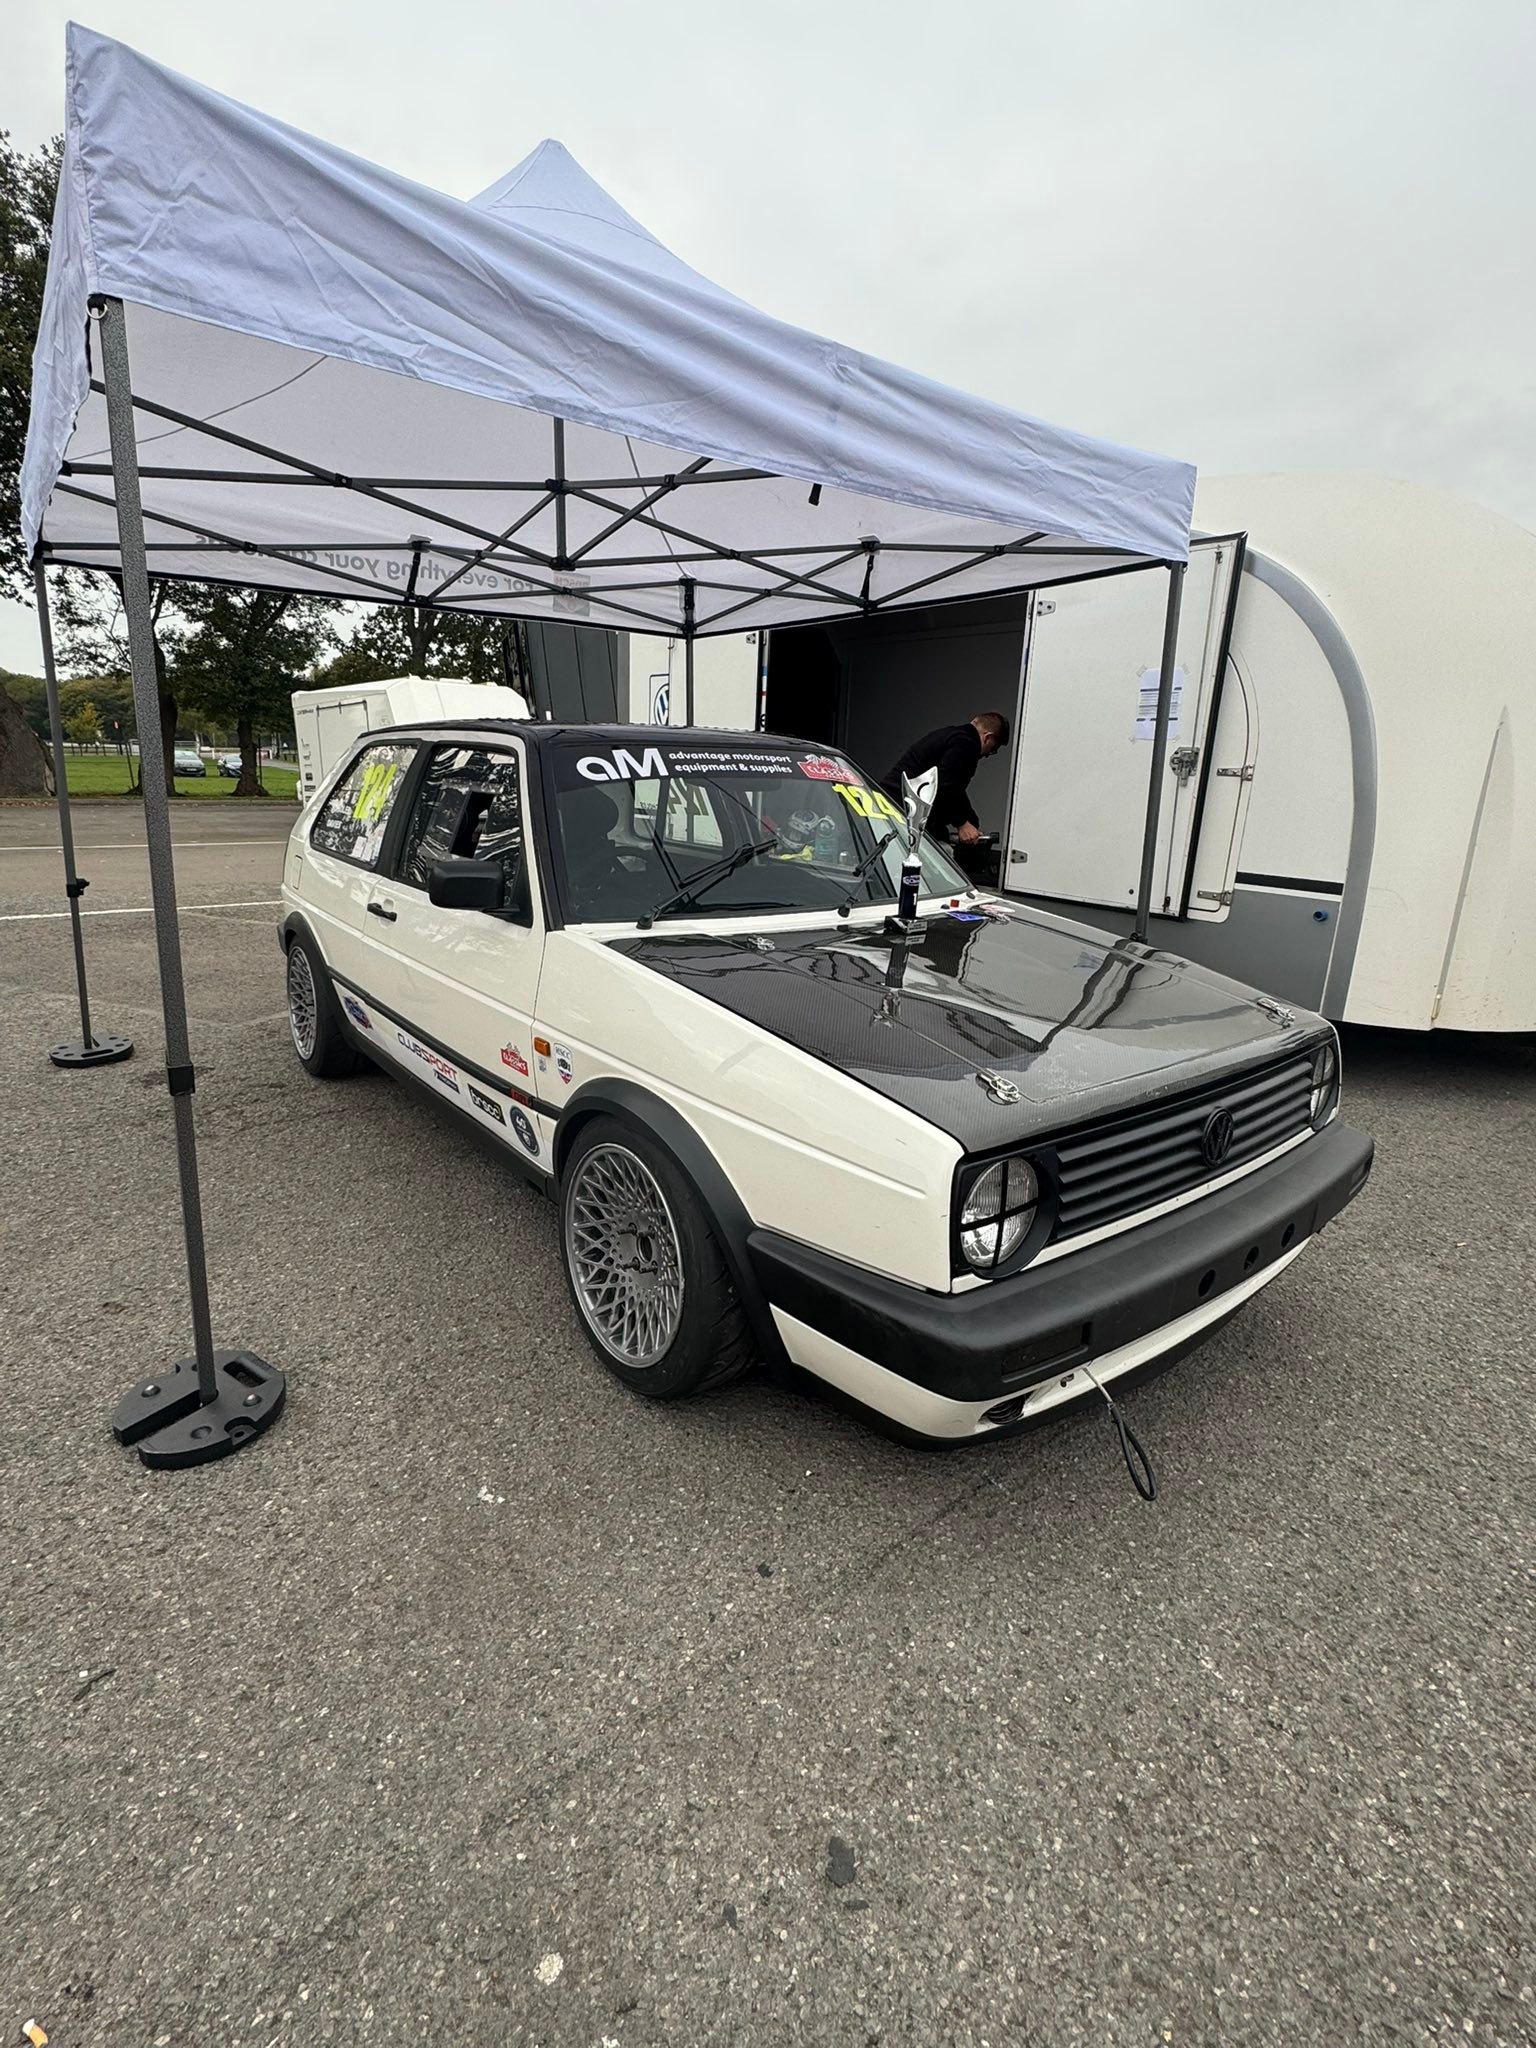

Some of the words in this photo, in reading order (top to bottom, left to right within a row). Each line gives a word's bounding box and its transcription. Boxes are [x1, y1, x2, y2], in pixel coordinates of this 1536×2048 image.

[668, 751, 731, 761] advantage
[732, 753, 792, 763] motorsport
[675, 763, 738, 773] equipment
[739, 763, 748, 771] &
[749, 764, 793, 774] supplies
[832, 784, 906, 824] 124
